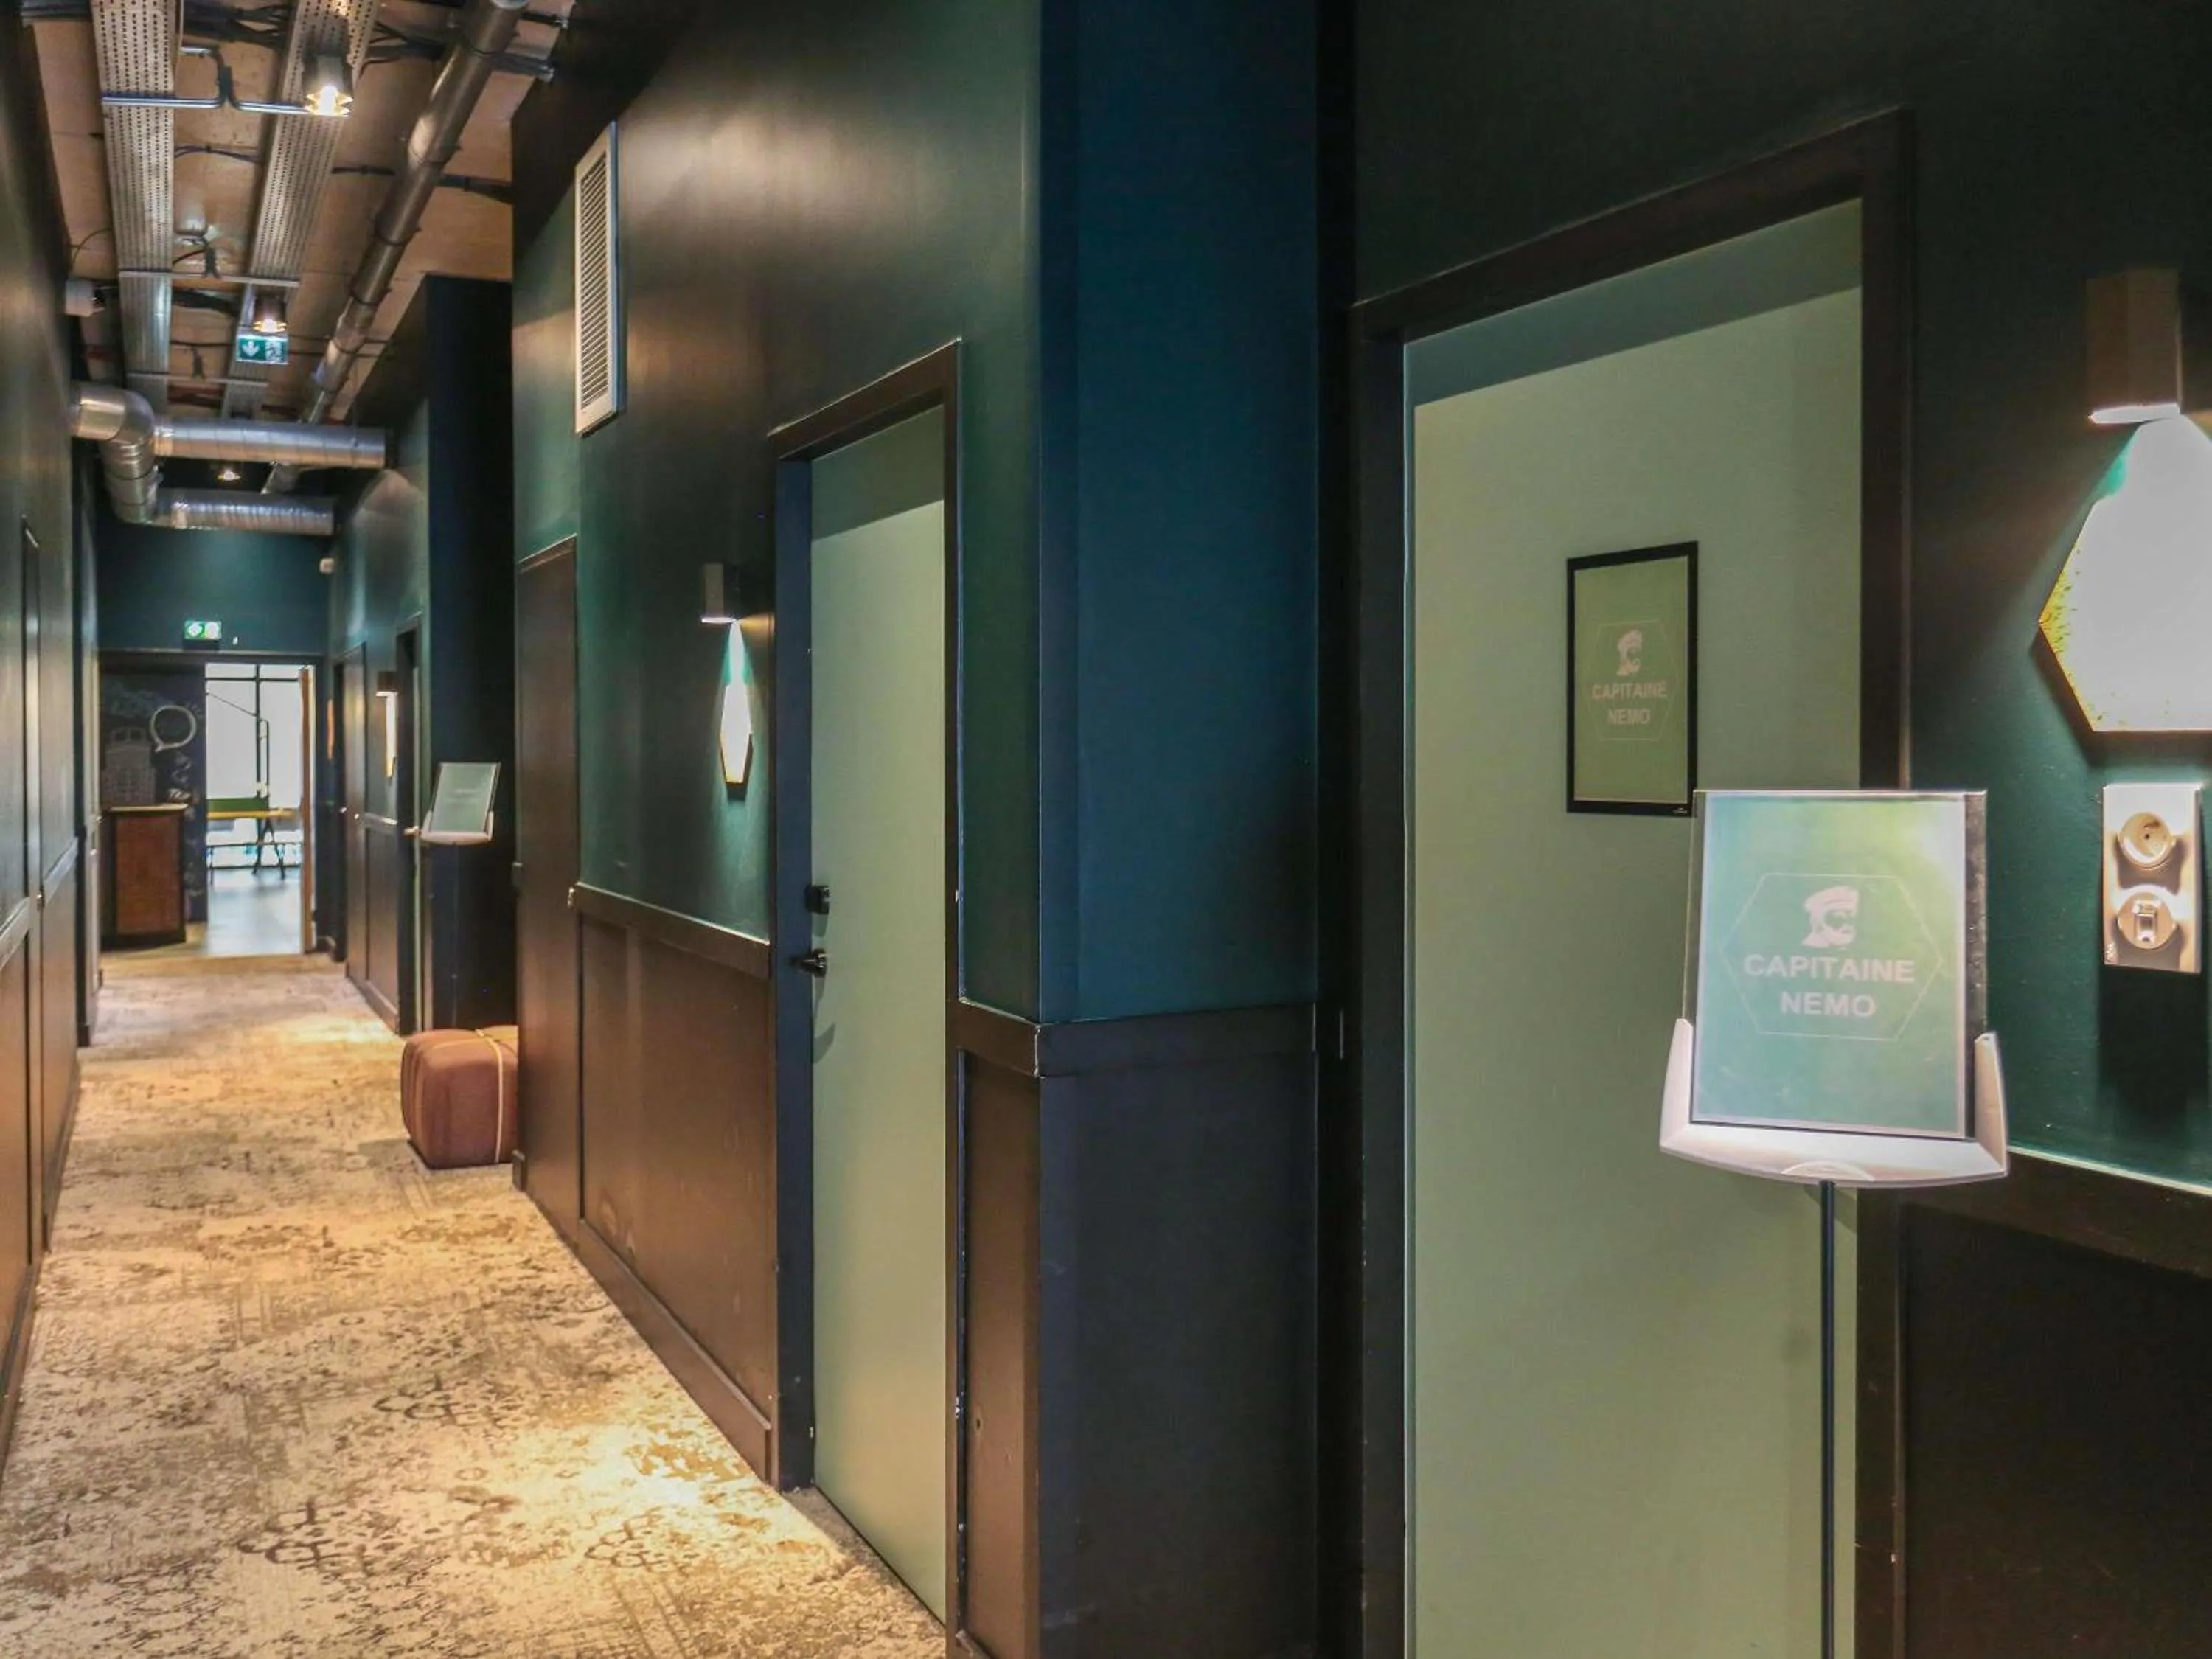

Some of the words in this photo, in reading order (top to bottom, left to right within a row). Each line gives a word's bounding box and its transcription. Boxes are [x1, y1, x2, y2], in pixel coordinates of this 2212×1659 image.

[1592, 681, 1667, 700] CAPITAINE
[1608, 708, 1651, 725] NEMO
[1743, 954, 1915, 984] CAPITAINE
[1780, 991, 1877, 1017] NEMO
